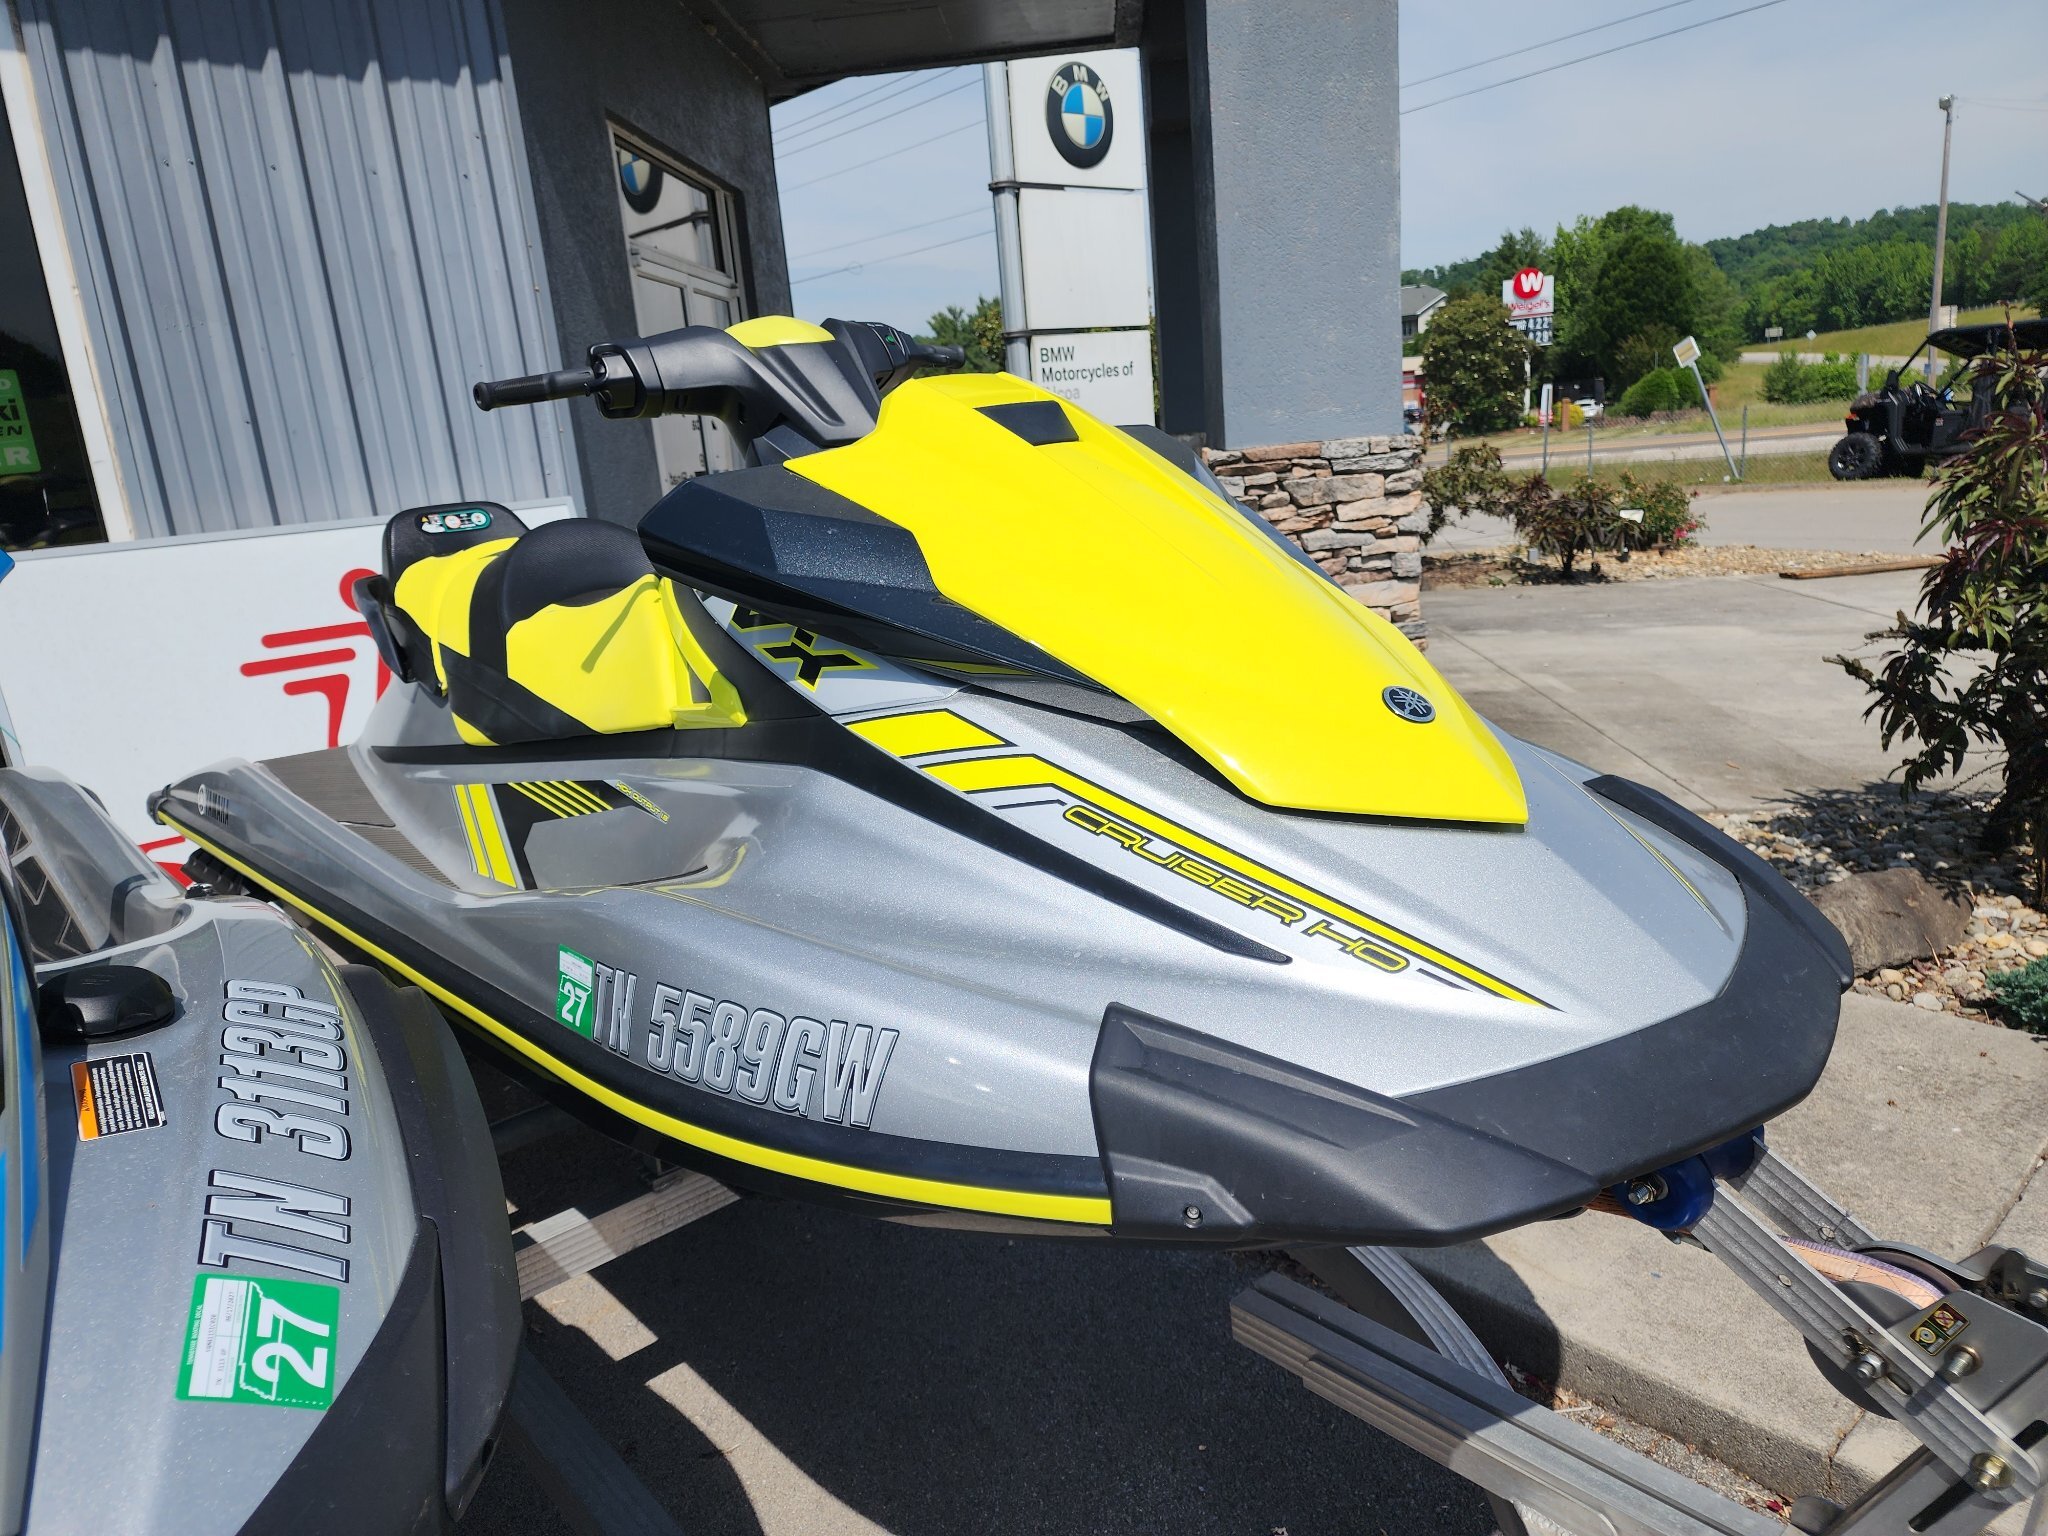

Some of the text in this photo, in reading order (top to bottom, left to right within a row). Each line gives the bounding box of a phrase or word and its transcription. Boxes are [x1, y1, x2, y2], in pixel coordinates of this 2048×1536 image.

[1050, 64, 1109, 102] BMW
[1521, 271, 1543, 292] W
[1040, 346, 1075, 363] BMW
[1042, 361, 1134, 383] Motorcycles of
[1062, 804, 1411, 974] CRUISER HO
[561, 981, 588, 1027] 27
[594, 961, 900, 1130] TN 5589GW
[198, 979, 352, 1283] TN 3113GP
[251, 1297, 330, 1389] 27
